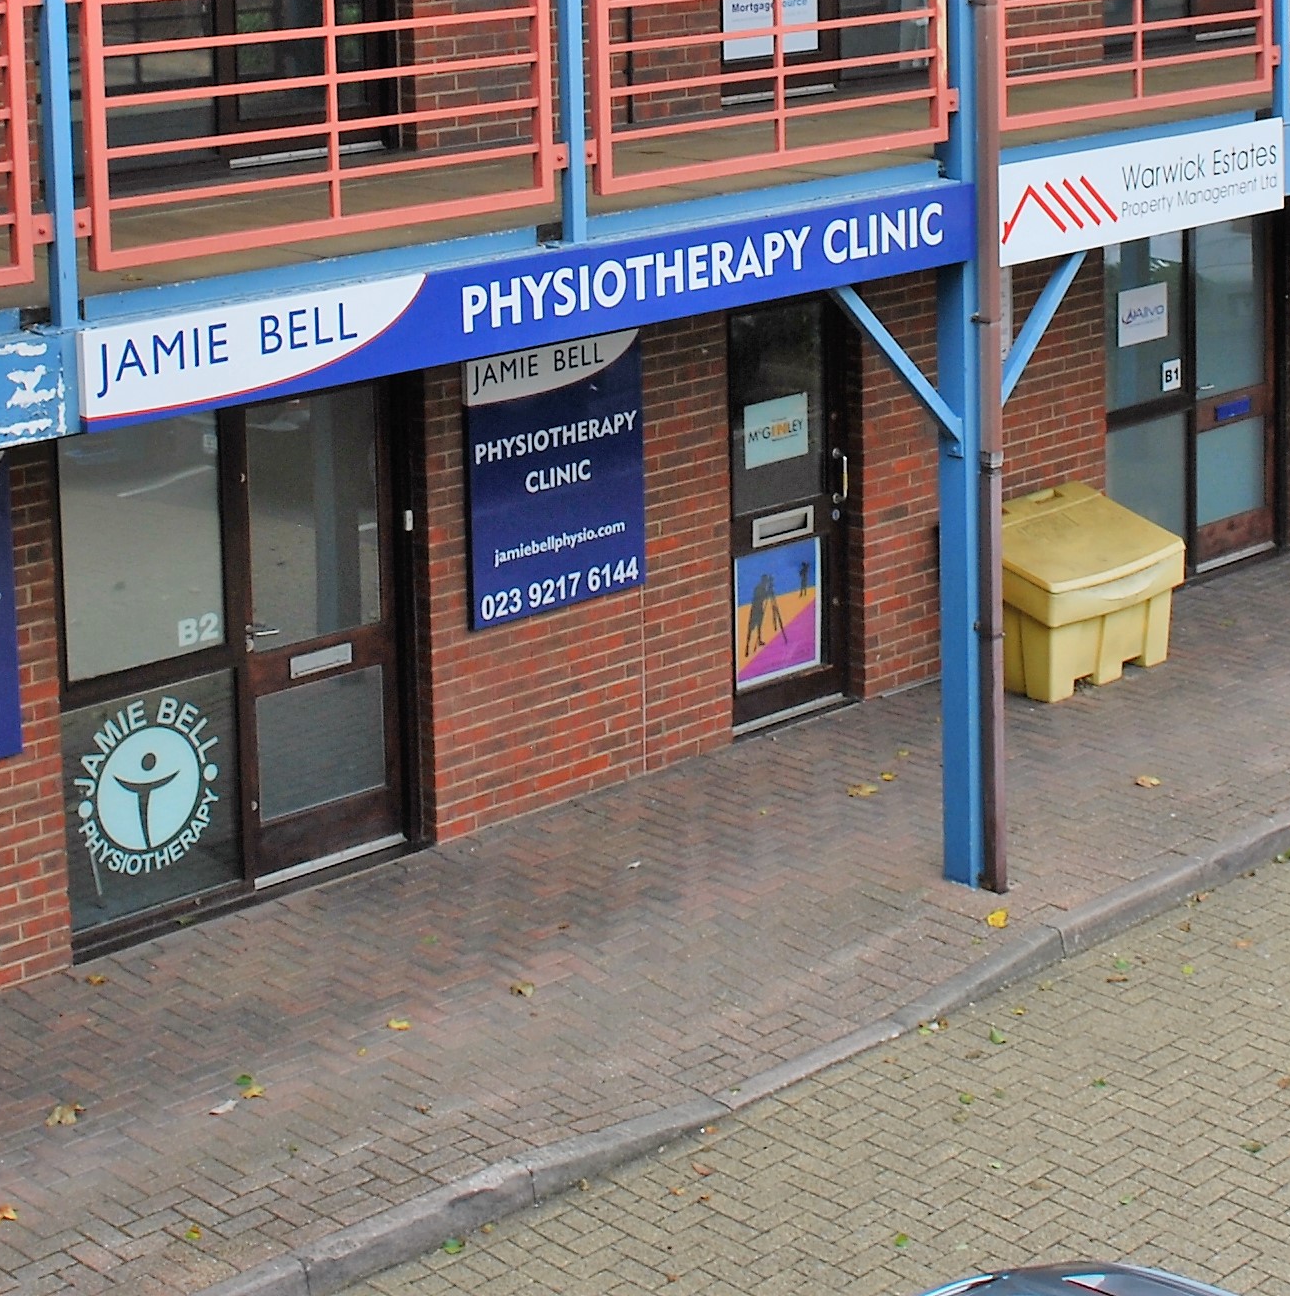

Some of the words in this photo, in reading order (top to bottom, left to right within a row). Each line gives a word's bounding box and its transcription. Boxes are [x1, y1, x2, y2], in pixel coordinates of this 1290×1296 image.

[1122, 153, 1206, 192] Warwick
[1212, 143, 1277, 174] Estates
[1121, 194, 1172, 219] Property
[1176, 177, 1258, 208] Management
[1260, 172, 1278, 190] Ltd
[461, 224, 811, 335] PHYSIOTHERAPY
[821, 201, 945, 264] CLINIC
[97, 322, 229, 398] JAMIE
[260, 302, 358, 356] BELL
[473, 354, 539, 396] JAMIE
[553, 342, 604, 372] BELL
[1165, 367, 1179, 384] B1
[474, 410, 638, 465] PHYSIOTHERAPY
[525, 459, 592, 494] CLINIC
[493, 520, 626, 568] jamiebellphysio.com
[481, 587, 522, 621] 023
[528, 572, 581, 608] 9217
[587, 556, 640, 590] 6144
[178, 612, 219, 648] B2
[73, 700, 148, 797] JAMIE
[156, 696, 219, 764] BELL
[78, 788, 219, 876] PHYSIOTHERAPY
